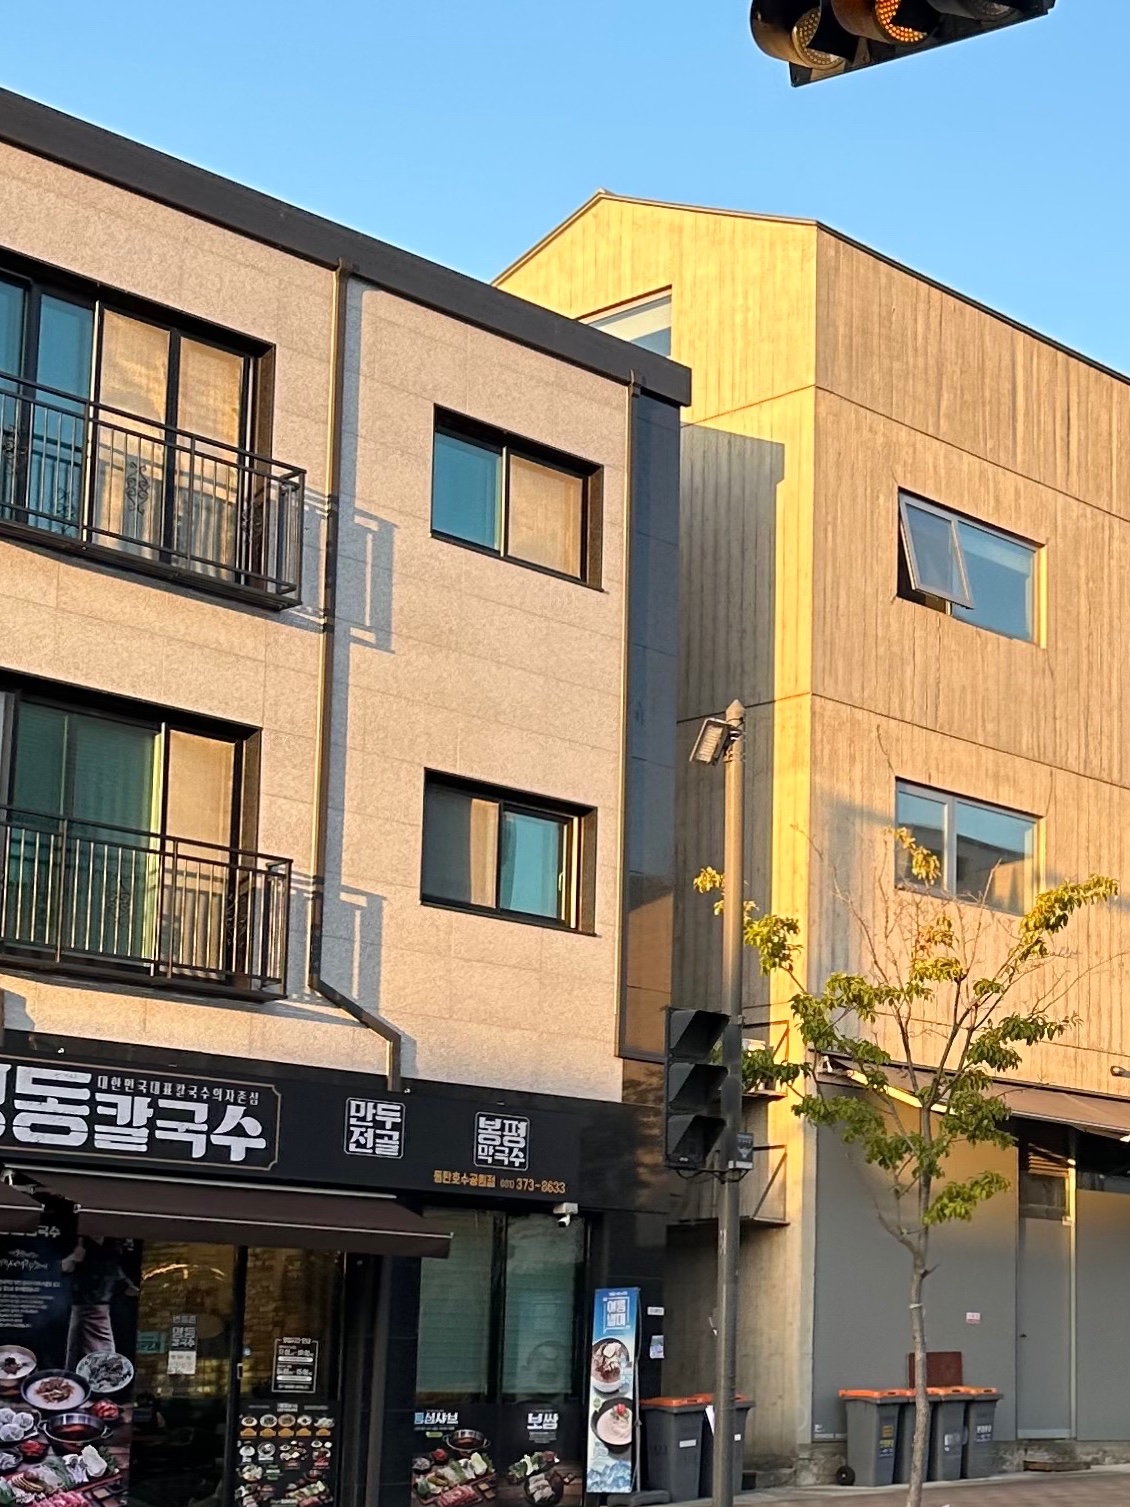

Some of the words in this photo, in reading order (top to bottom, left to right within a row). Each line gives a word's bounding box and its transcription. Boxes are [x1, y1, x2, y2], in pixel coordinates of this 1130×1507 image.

[0, 1063, 267, 1162] 동칼국수
[350, 1100, 402, 1129] 만두
[349, 1127, 400, 1156] 전골
[478, 1116, 528, 1148] 봉평
[477, 1145, 526, 1167] 막국수
